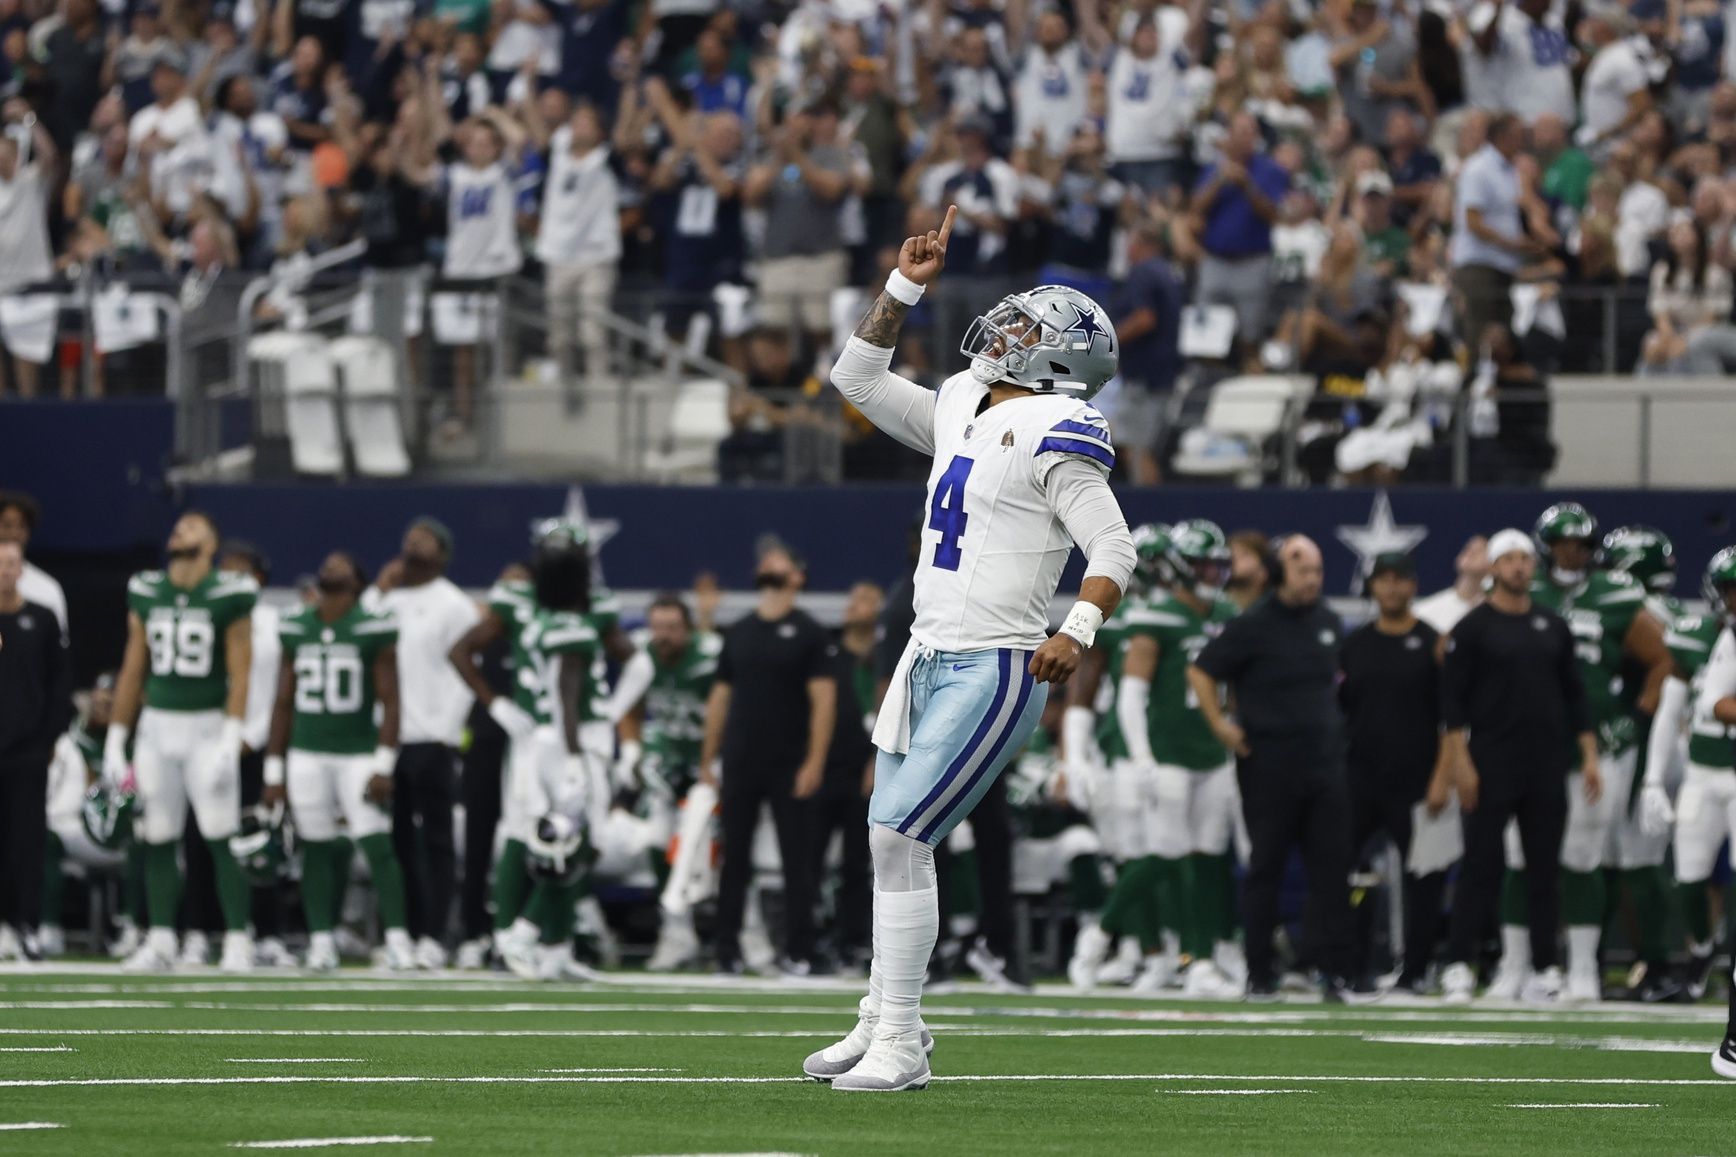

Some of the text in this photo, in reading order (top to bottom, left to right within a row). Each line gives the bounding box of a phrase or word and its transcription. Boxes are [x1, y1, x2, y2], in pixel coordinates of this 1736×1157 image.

[928, 454, 975, 572] 4
[146, 622, 215, 677] 99
[294, 657, 363, 713] 20
